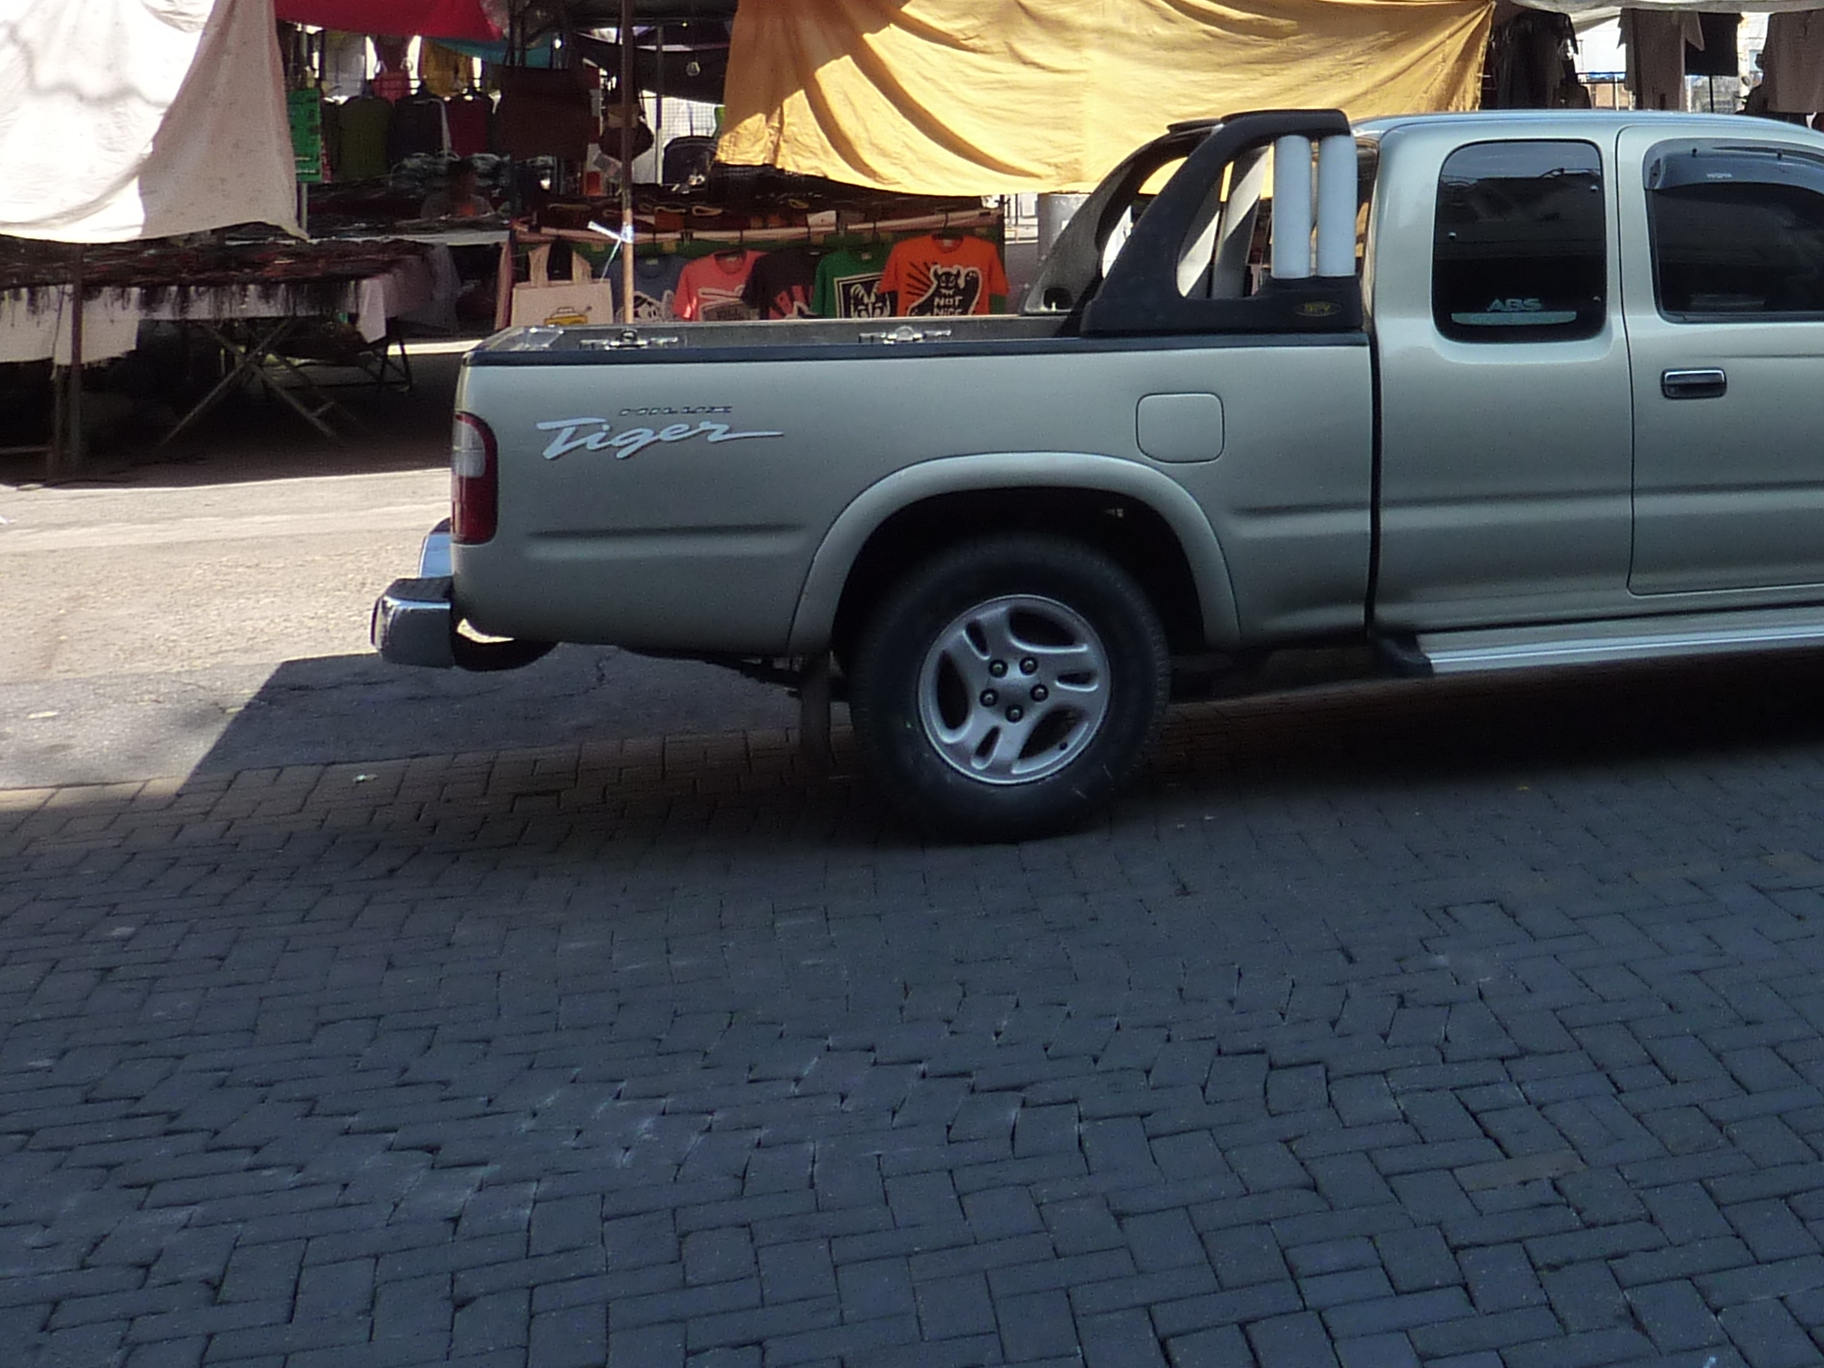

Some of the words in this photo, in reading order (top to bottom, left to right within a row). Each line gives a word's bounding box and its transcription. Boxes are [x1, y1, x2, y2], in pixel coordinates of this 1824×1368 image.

[934, 296, 963, 306] NOT
[1486, 297, 1543, 312] ABS
[536, 416, 785, 460] Tiger
